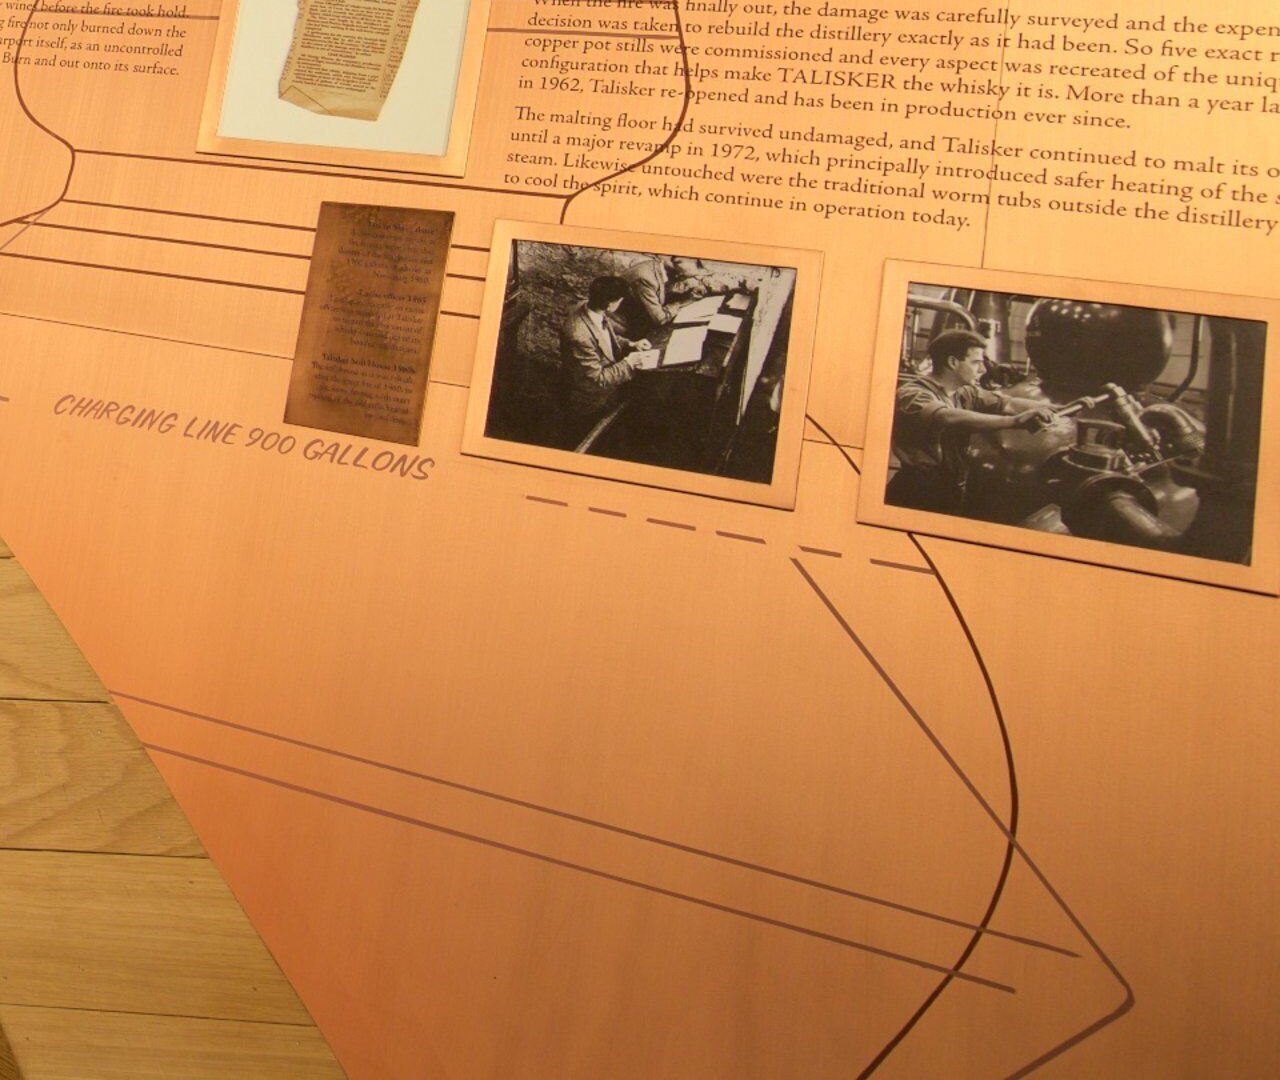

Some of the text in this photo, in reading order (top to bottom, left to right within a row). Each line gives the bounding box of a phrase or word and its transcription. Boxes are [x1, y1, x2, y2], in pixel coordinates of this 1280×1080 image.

[518, 75, 1131, 129] in 1962, Talisker re-opened and has been in production ever since.
[503, 172, 971, 231] to cool the spirit, which continue in operation today.
[53, 394, 437, 481] CHARGING LINE 900 GALLONS
